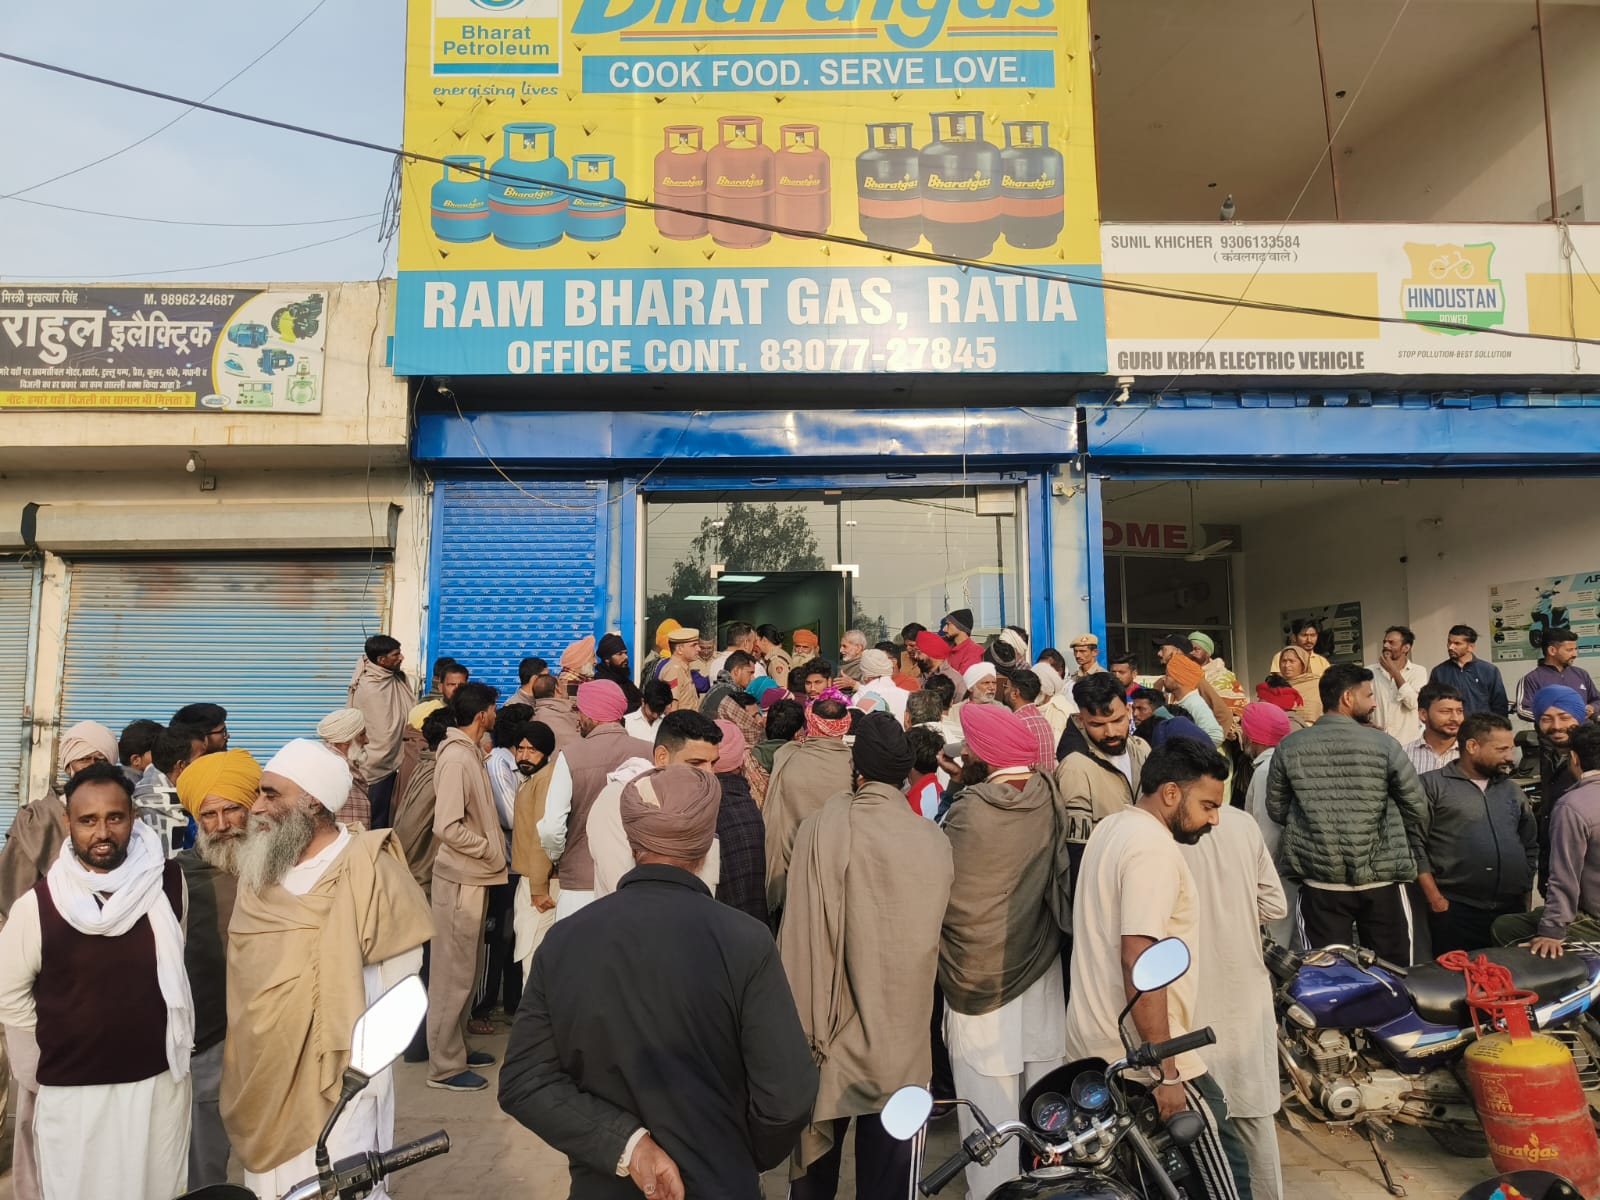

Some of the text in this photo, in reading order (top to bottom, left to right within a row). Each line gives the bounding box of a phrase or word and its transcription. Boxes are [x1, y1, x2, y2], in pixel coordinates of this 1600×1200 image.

[461, 25, 532, 40] Bharat
[443, 40, 550, 56] Petroleum
[608, 56, 1027, 88] COOK FOOD. SERVE LOVE.
[433, 80, 559, 98] energising lives
[928, 171, 992, 192] Bharatgas
[1111, 235, 1301, 249] SUNIL KHICHER 9306133584
[143, 293, 235, 306] M. 98962-24687
[423, 276, 1078, 330] RAM BHARAT GAS, RATIA
[1407, 287, 1498, 309] HINDUSTAN
[0, 309, 107, 365] राहुल
[507, 336, 997, 374] OFFICE CONT. 83077-27845
[1117, 351, 1365, 370] GURU KRIPA ELECTRIC VEHICLE
[1398, 350, 1416, 359] STOP
[1103, 520, 1188, 549] OME
[1488, 1136, 1559, 1163] haratgas
